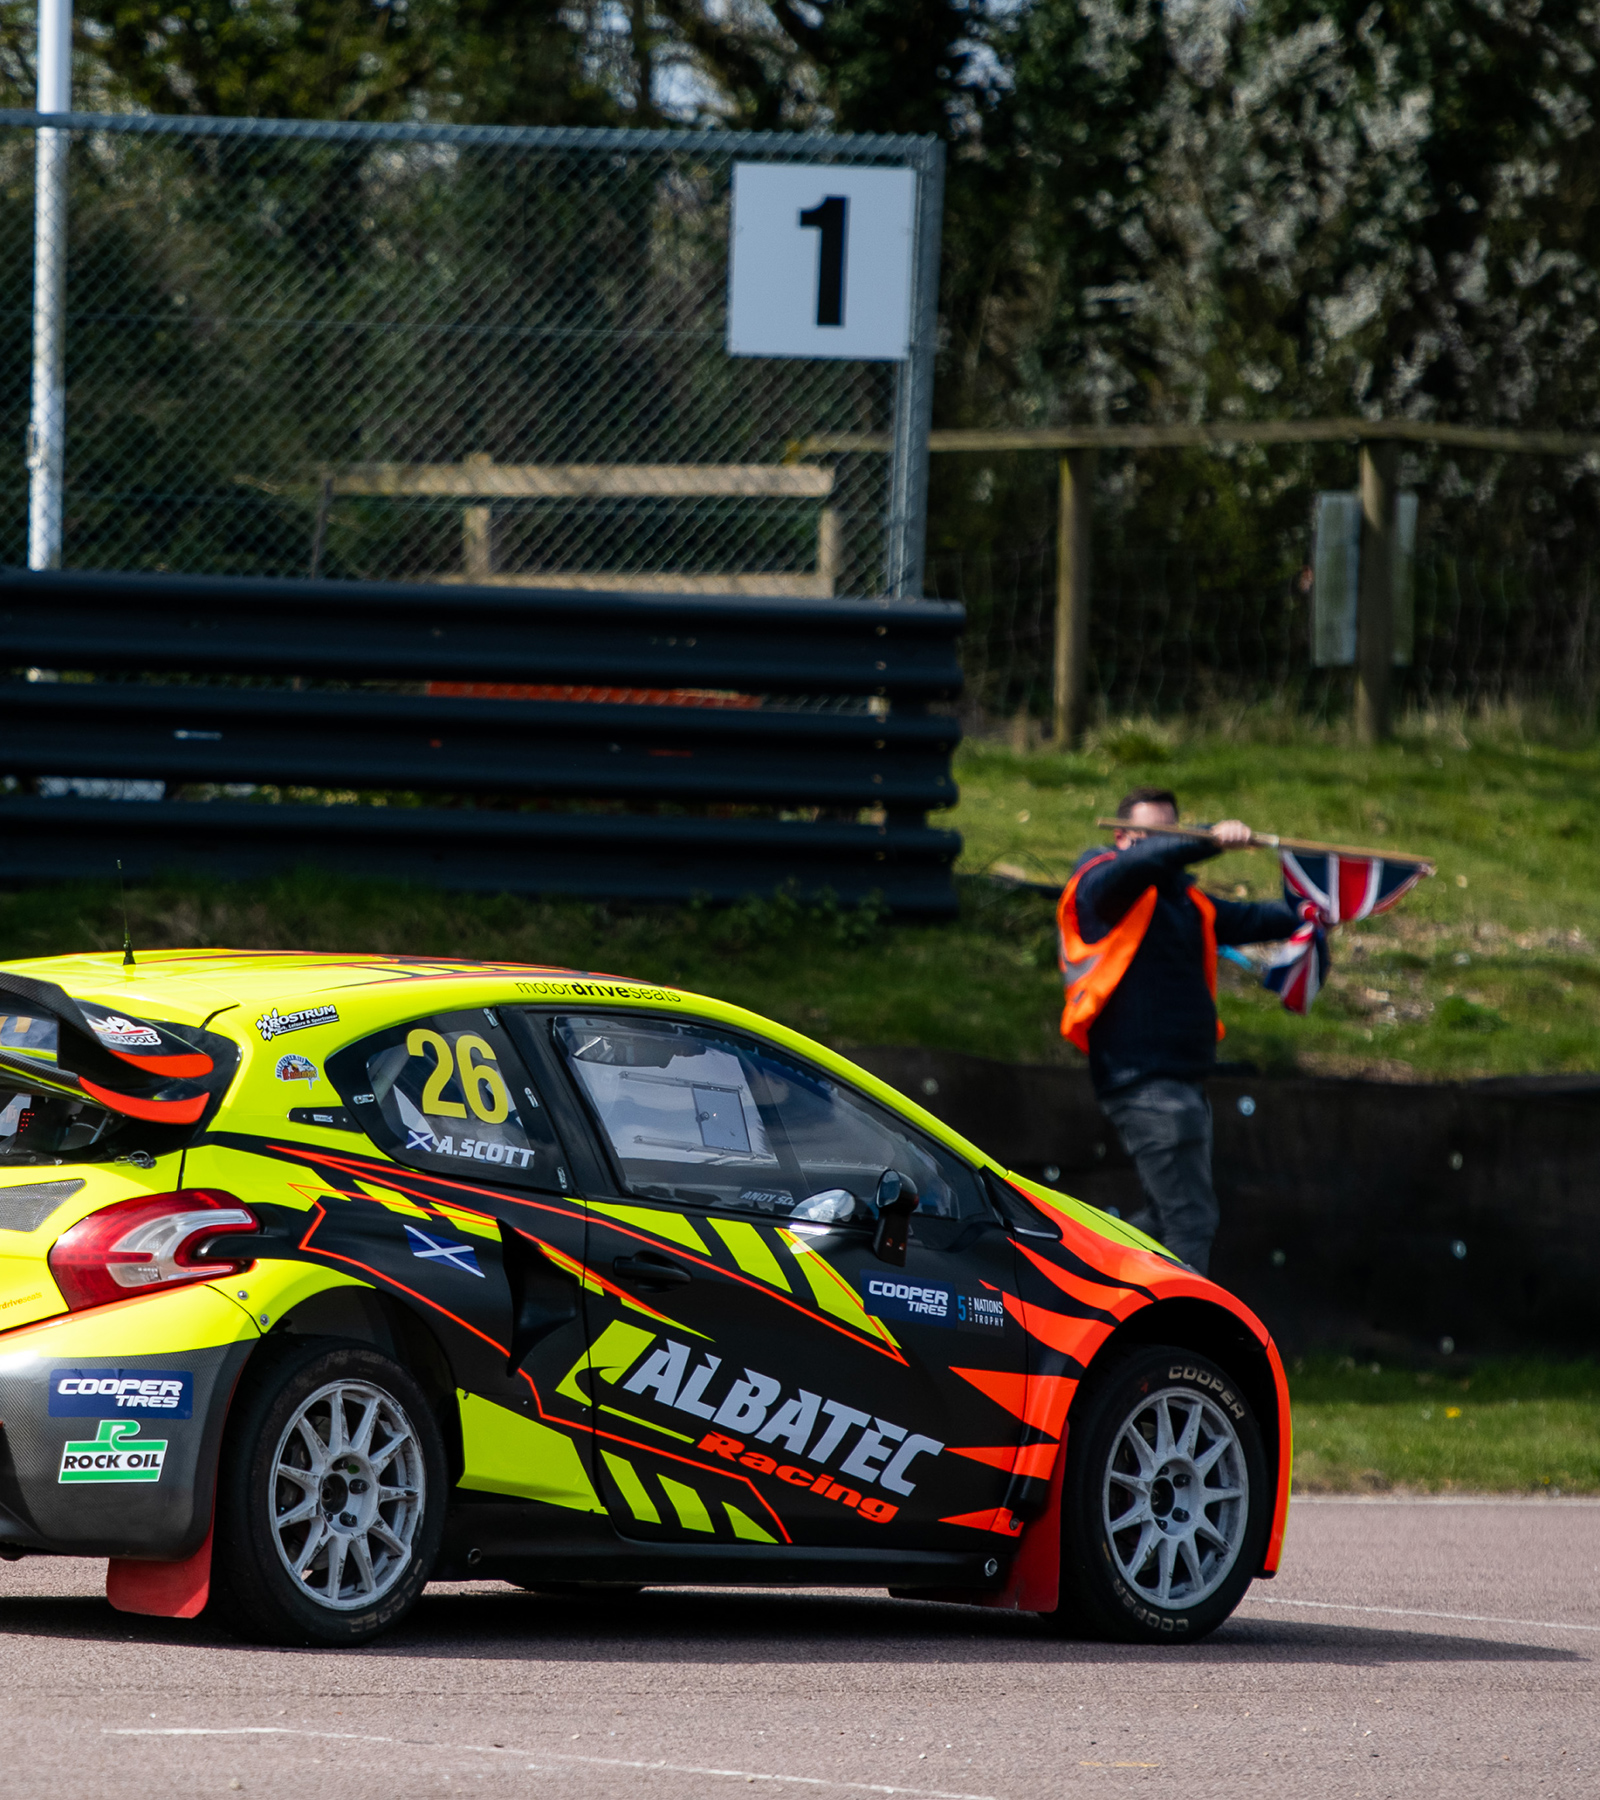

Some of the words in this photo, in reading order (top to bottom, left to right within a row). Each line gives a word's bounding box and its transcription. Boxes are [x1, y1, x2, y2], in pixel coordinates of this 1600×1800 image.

[798, 194, 850, 327] 1
[515, 981, 682, 1003] motordriveseats
[268, 1004, 337, 1029] ROSTRUM
[406, 1028, 509, 1125] 26
[436, 1135, 536, 1168] A.SCOTT
[740, 1190, 777, 1203] ANDY
[868, 1280, 949, 1306] COOPER
[907, 1300, 948, 1317] TIRES
[957, 1295, 967, 1321] 5
[973, 1297, 1004, 1315] NATIONS
[974, 1313, 1004, 1327] TROPHY
[57, 1378, 183, 1396] COOPER
[1168, 1365, 1246, 1421] COOPER
[115, 1394, 180, 1409] TIRES
[622, 1338, 945, 1497] ALBATEC
[63, 1454, 122, 1469] ROCK
[126, 1453, 161, 1468] OIL
[697, 1430, 900, 1525] Racing
